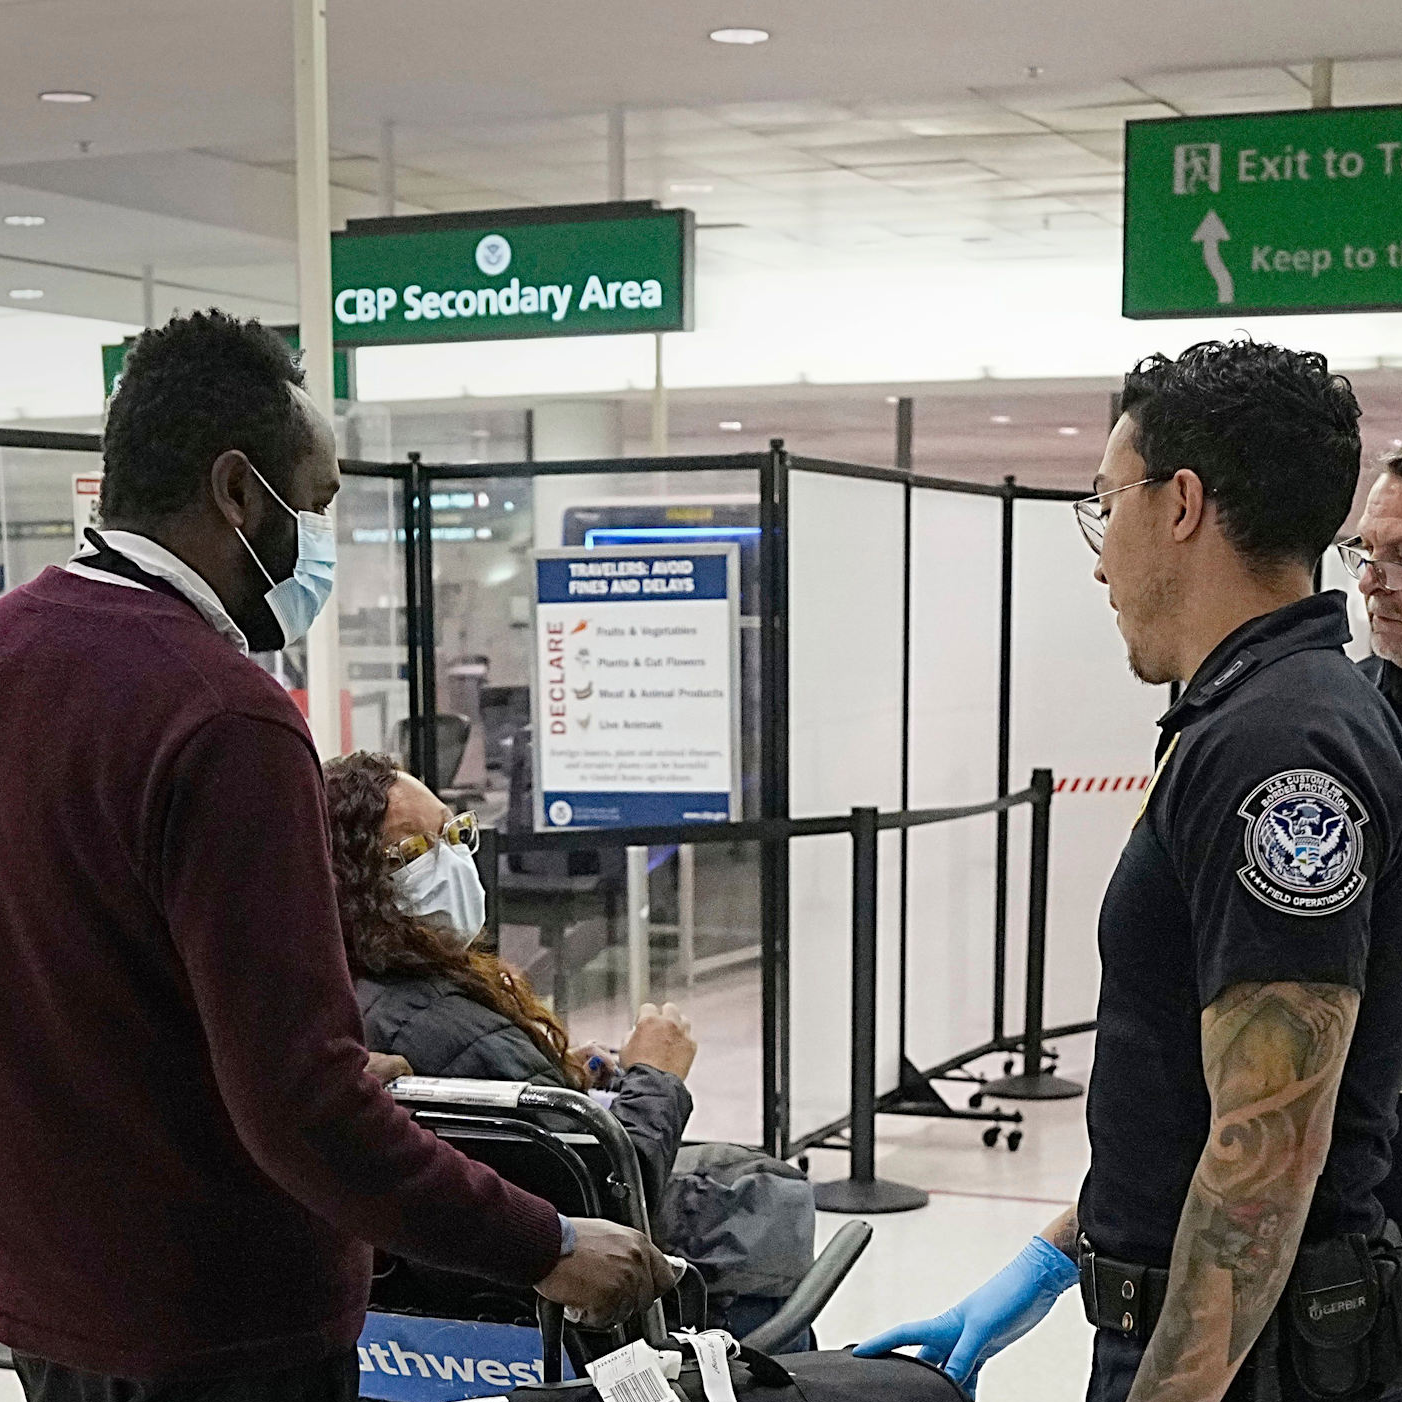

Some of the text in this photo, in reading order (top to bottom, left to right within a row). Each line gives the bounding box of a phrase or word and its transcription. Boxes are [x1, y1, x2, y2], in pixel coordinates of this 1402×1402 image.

[1236, 147, 1312, 184] Exit
[1323, 147, 1365, 180] to
[1250, 245, 1333, 279] Keep
[1342, 244, 1378, 270] to
[334, 274, 663, 324] CBP Secondary Area
[568, 560, 694, 578] TRAVELERS: AVOID
[568, 577, 695, 595] FINES AND DELAYS
[596, 626, 697, 638] Fruits & Vegetables
[598, 656, 705, 667] Plants & Cut Flowers
[547, 620, 567, 735] DECLARE
[641, 689, 674, 698] Animal
[678, 688, 724, 698] Products
[599, 720, 663, 730] Live Animals
[1266, 779, 1285, 794] U.S.
[1286, 774, 1331, 789] CUSTOMS
[1260, 783, 1350, 812] BORDER PROTECTION
[1265, 885, 1345, 907] FIELD OPERATIONS
